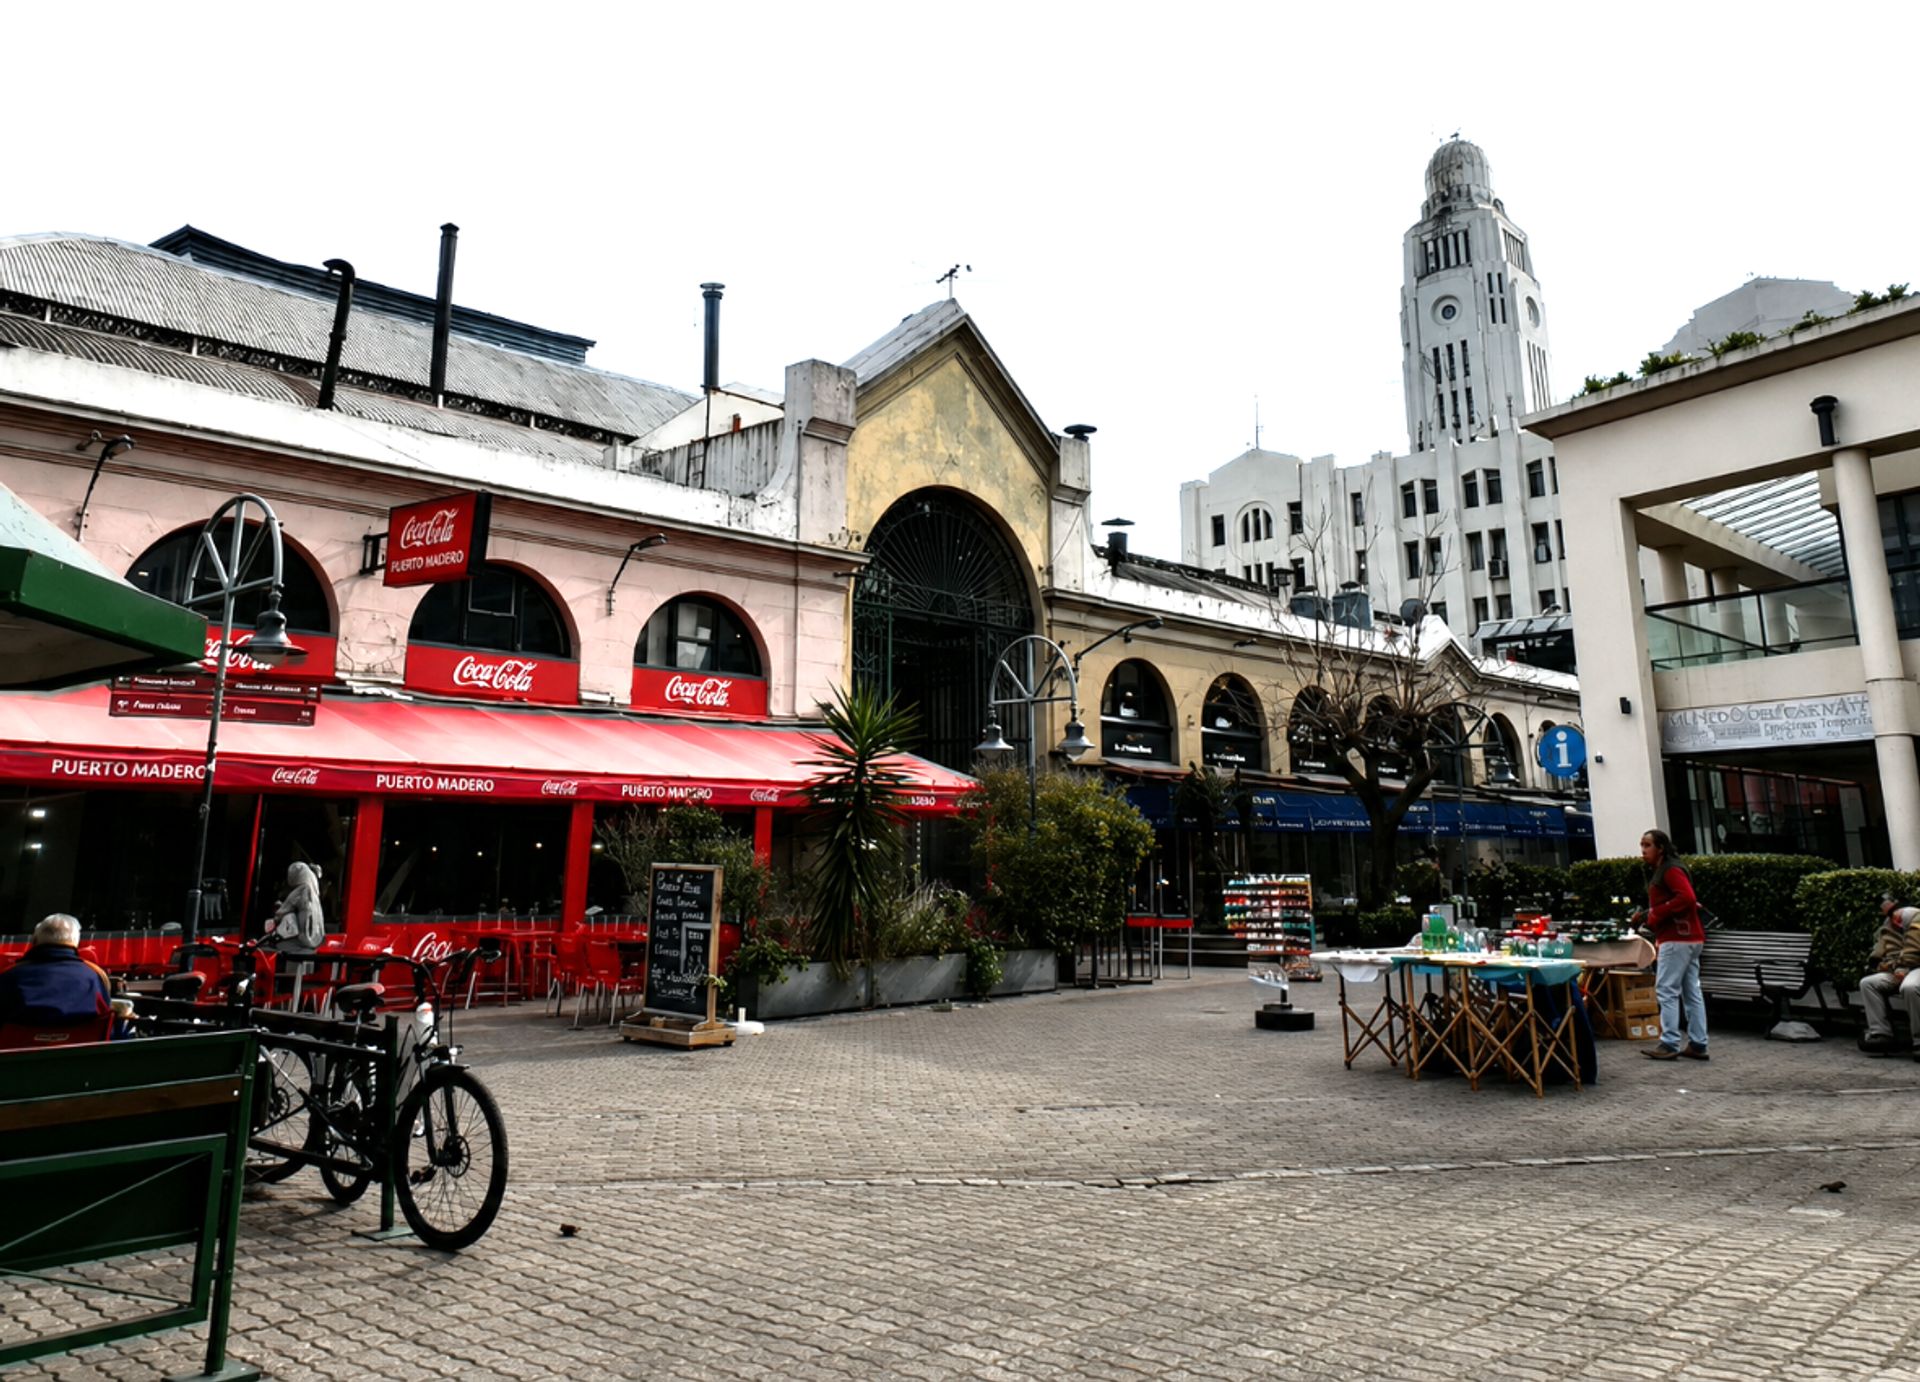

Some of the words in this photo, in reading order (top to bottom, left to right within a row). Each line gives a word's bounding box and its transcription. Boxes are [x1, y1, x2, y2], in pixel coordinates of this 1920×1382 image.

[400, 508, 459, 549] Coca-Cola
[391, 557, 423, 573] PUERTO
[426, 550, 464, 568] MADERO
[453, 656, 537, 691] Coca-Cola
[665, 675, 731, 706] Coca-Cola
[51, 759, 128, 778] PUERTO
[132, 763, 207, 780] MADERO
[272, 767, 320, 785] Coca-Cola
[376, 774, 434, 790] PUERTO
[437, 777, 495, 792] MADERO
[541, 780, 579, 796] Coca-Cola
[622, 784, 666, 798] PUERTO
